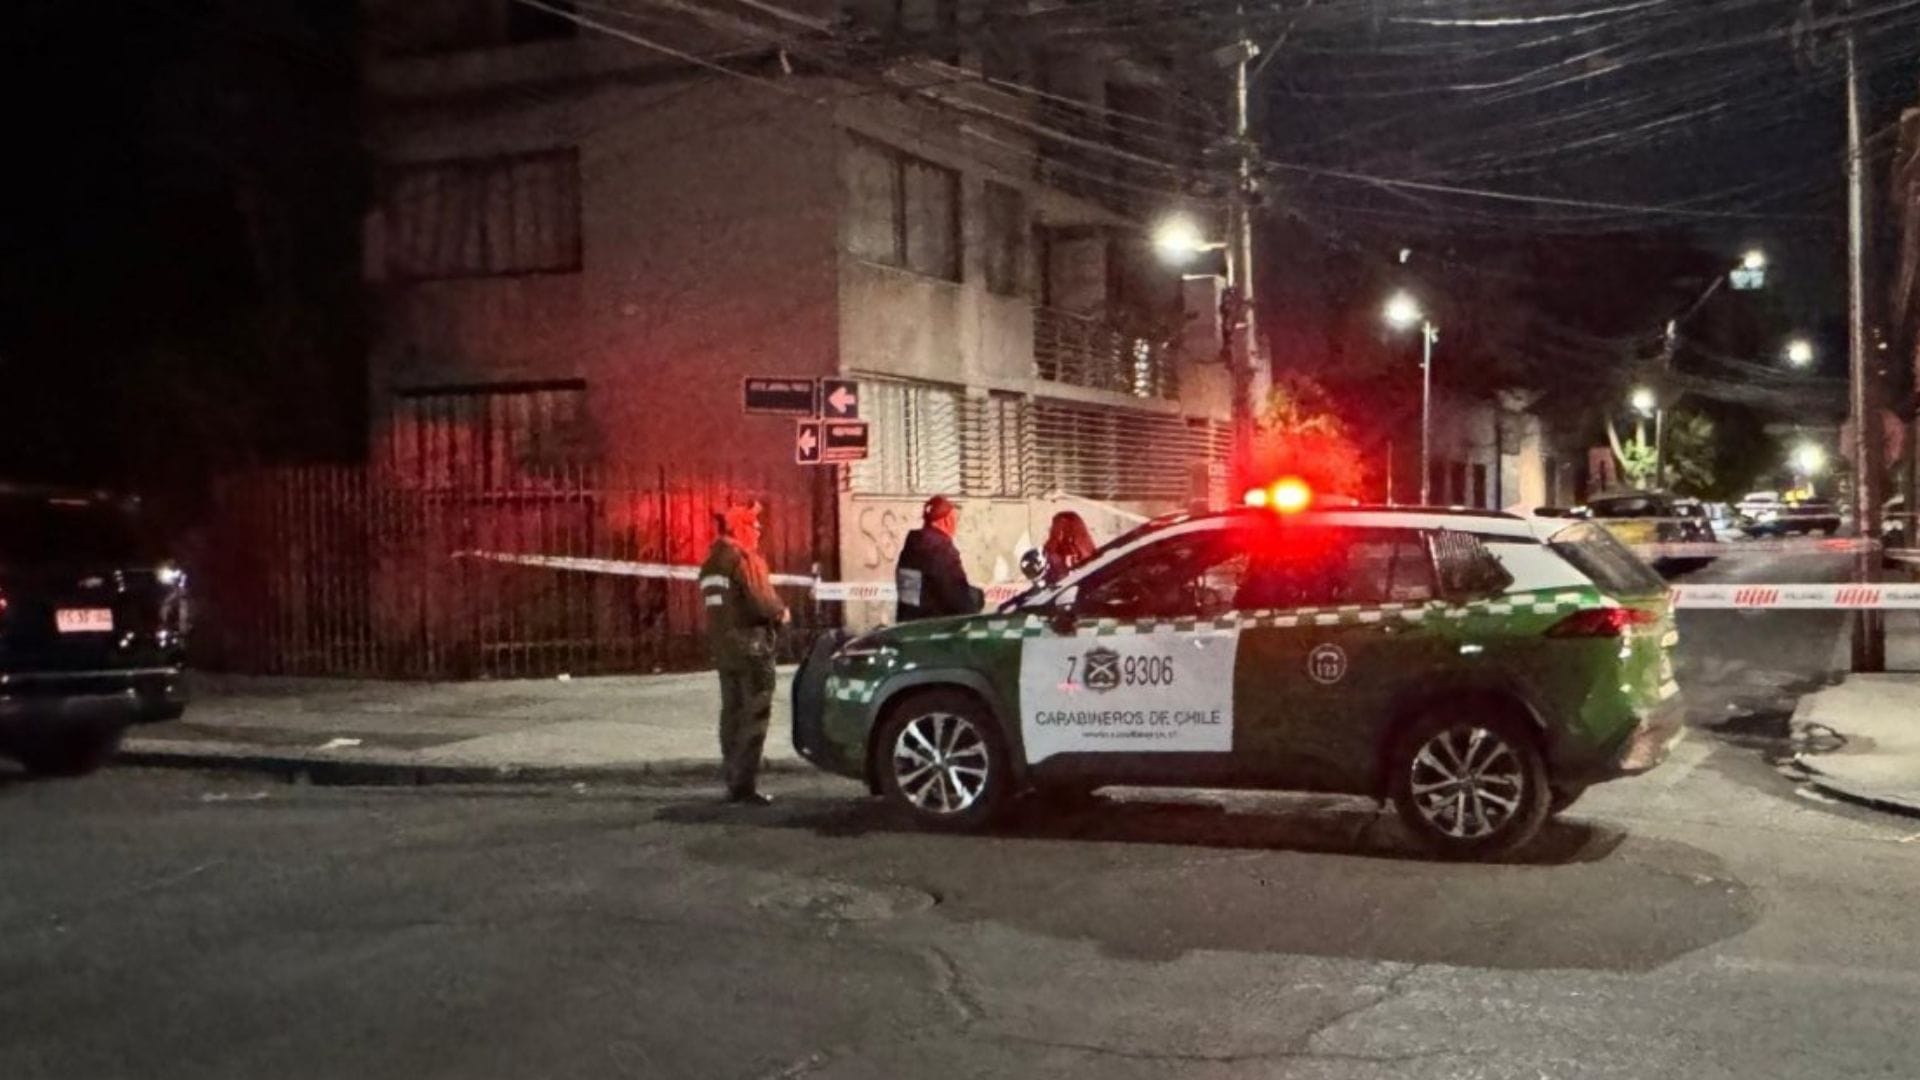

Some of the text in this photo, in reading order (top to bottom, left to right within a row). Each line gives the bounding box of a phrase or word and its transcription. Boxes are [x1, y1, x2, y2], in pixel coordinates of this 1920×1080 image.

[1124, 656, 1174, 686] 9306
[1035, 709, 1221, 727] CARABINEROS DE CHILE
